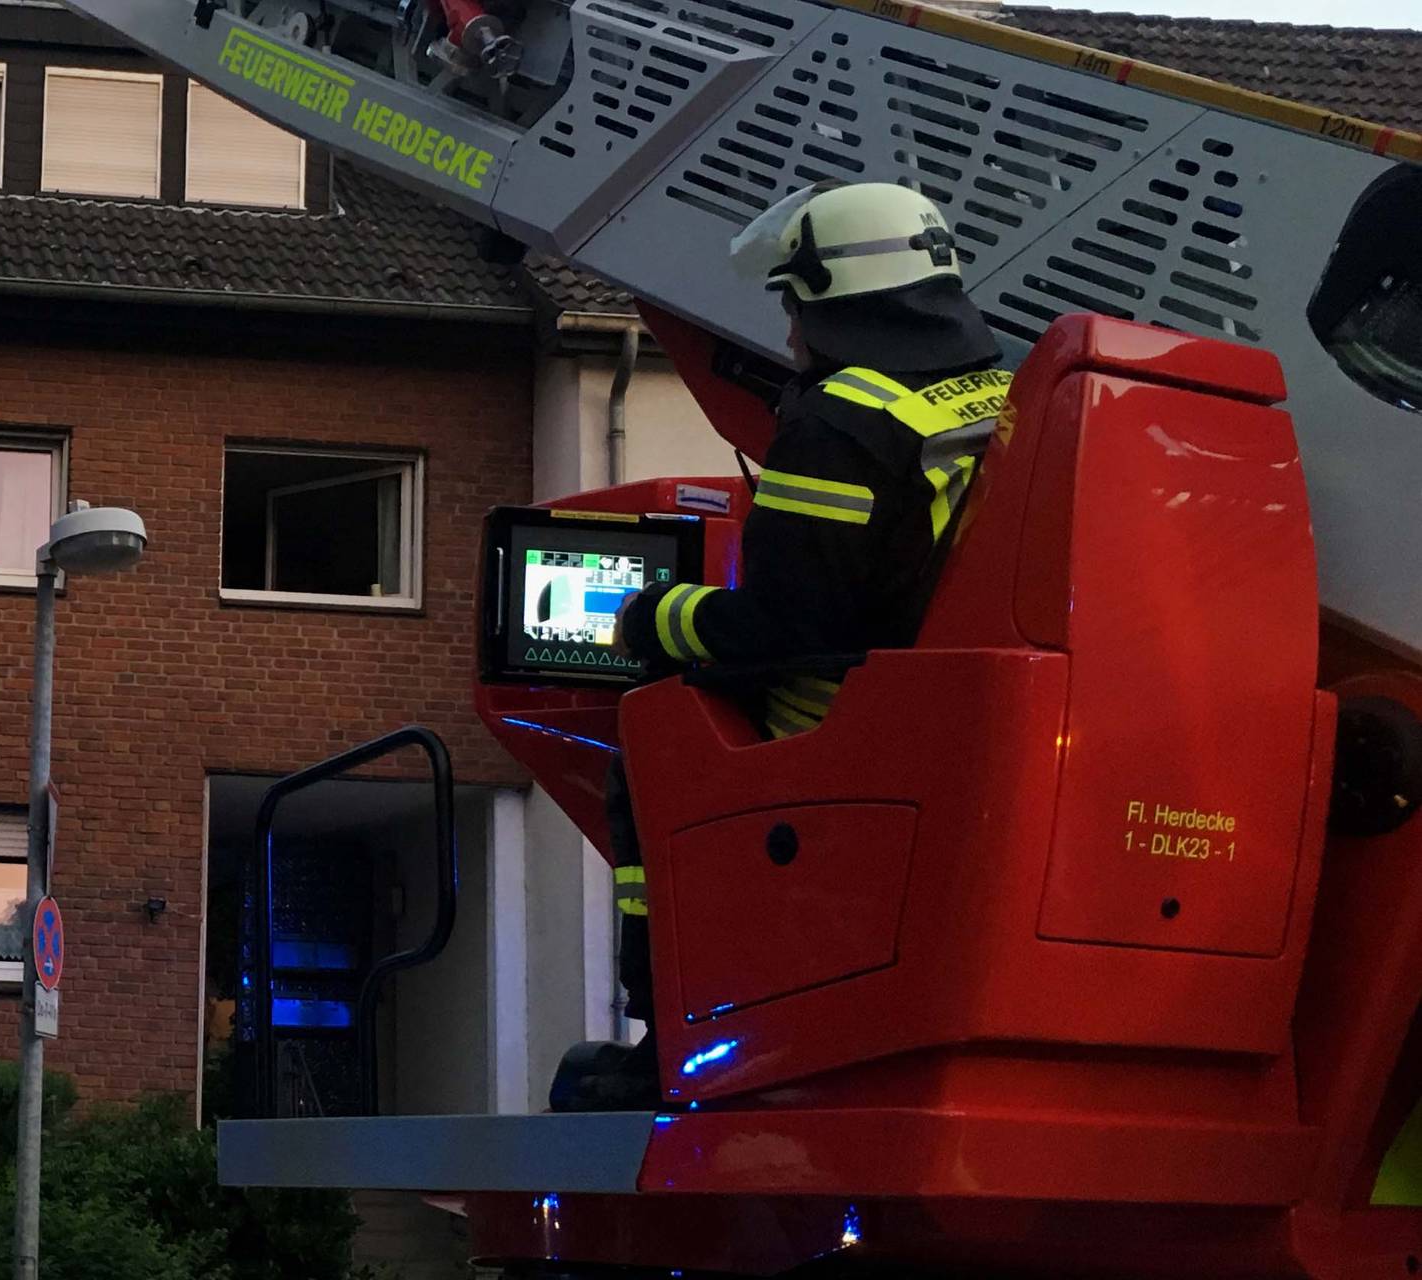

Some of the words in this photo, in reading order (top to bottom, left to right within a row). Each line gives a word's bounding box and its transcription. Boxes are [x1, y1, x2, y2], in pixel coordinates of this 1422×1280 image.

[1074, 50, 1111, 75] 14m
[219, 28, 354, 123] FEUERWEHR
[352, 99, 493, 188] HERDECKE
[1320, 115, 1365, 144] 12m
[1128, 801, 1148, 824] Fl.
[1154, 804, 1235, 832] Herdecke
[1125, 830, 1134, 851] 1
[1150, 834, 1210, 859] DLK23
[1227, 841, 1236, 863] 1
